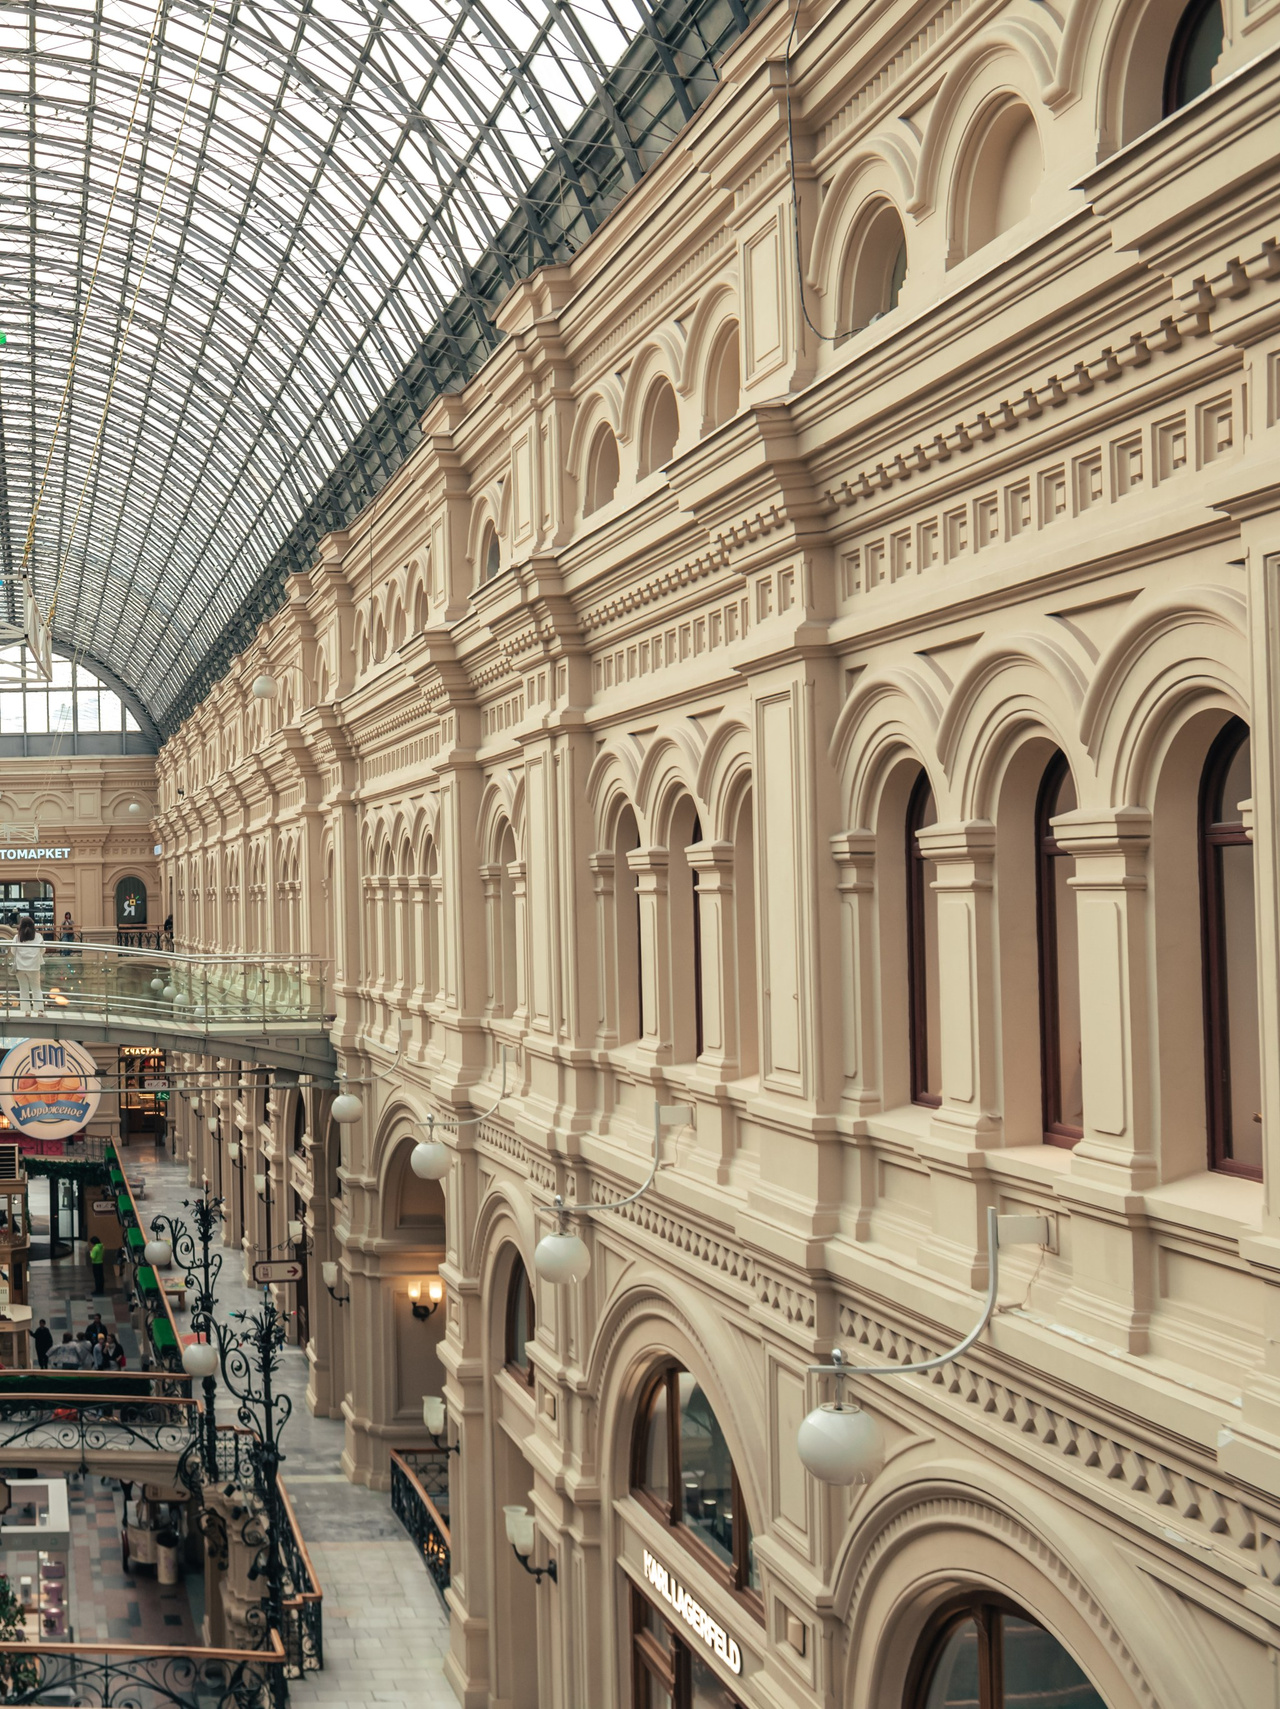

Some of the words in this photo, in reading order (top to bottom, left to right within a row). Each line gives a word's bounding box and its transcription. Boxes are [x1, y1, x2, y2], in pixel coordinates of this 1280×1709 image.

[31, 1044, 66, 1069] ГУМ
[19, 1104, 84, 1121] Мороженое
[643, 1549, 672, 1604] KARL
[671, 1577, 741, 1675] LAGERFELD
